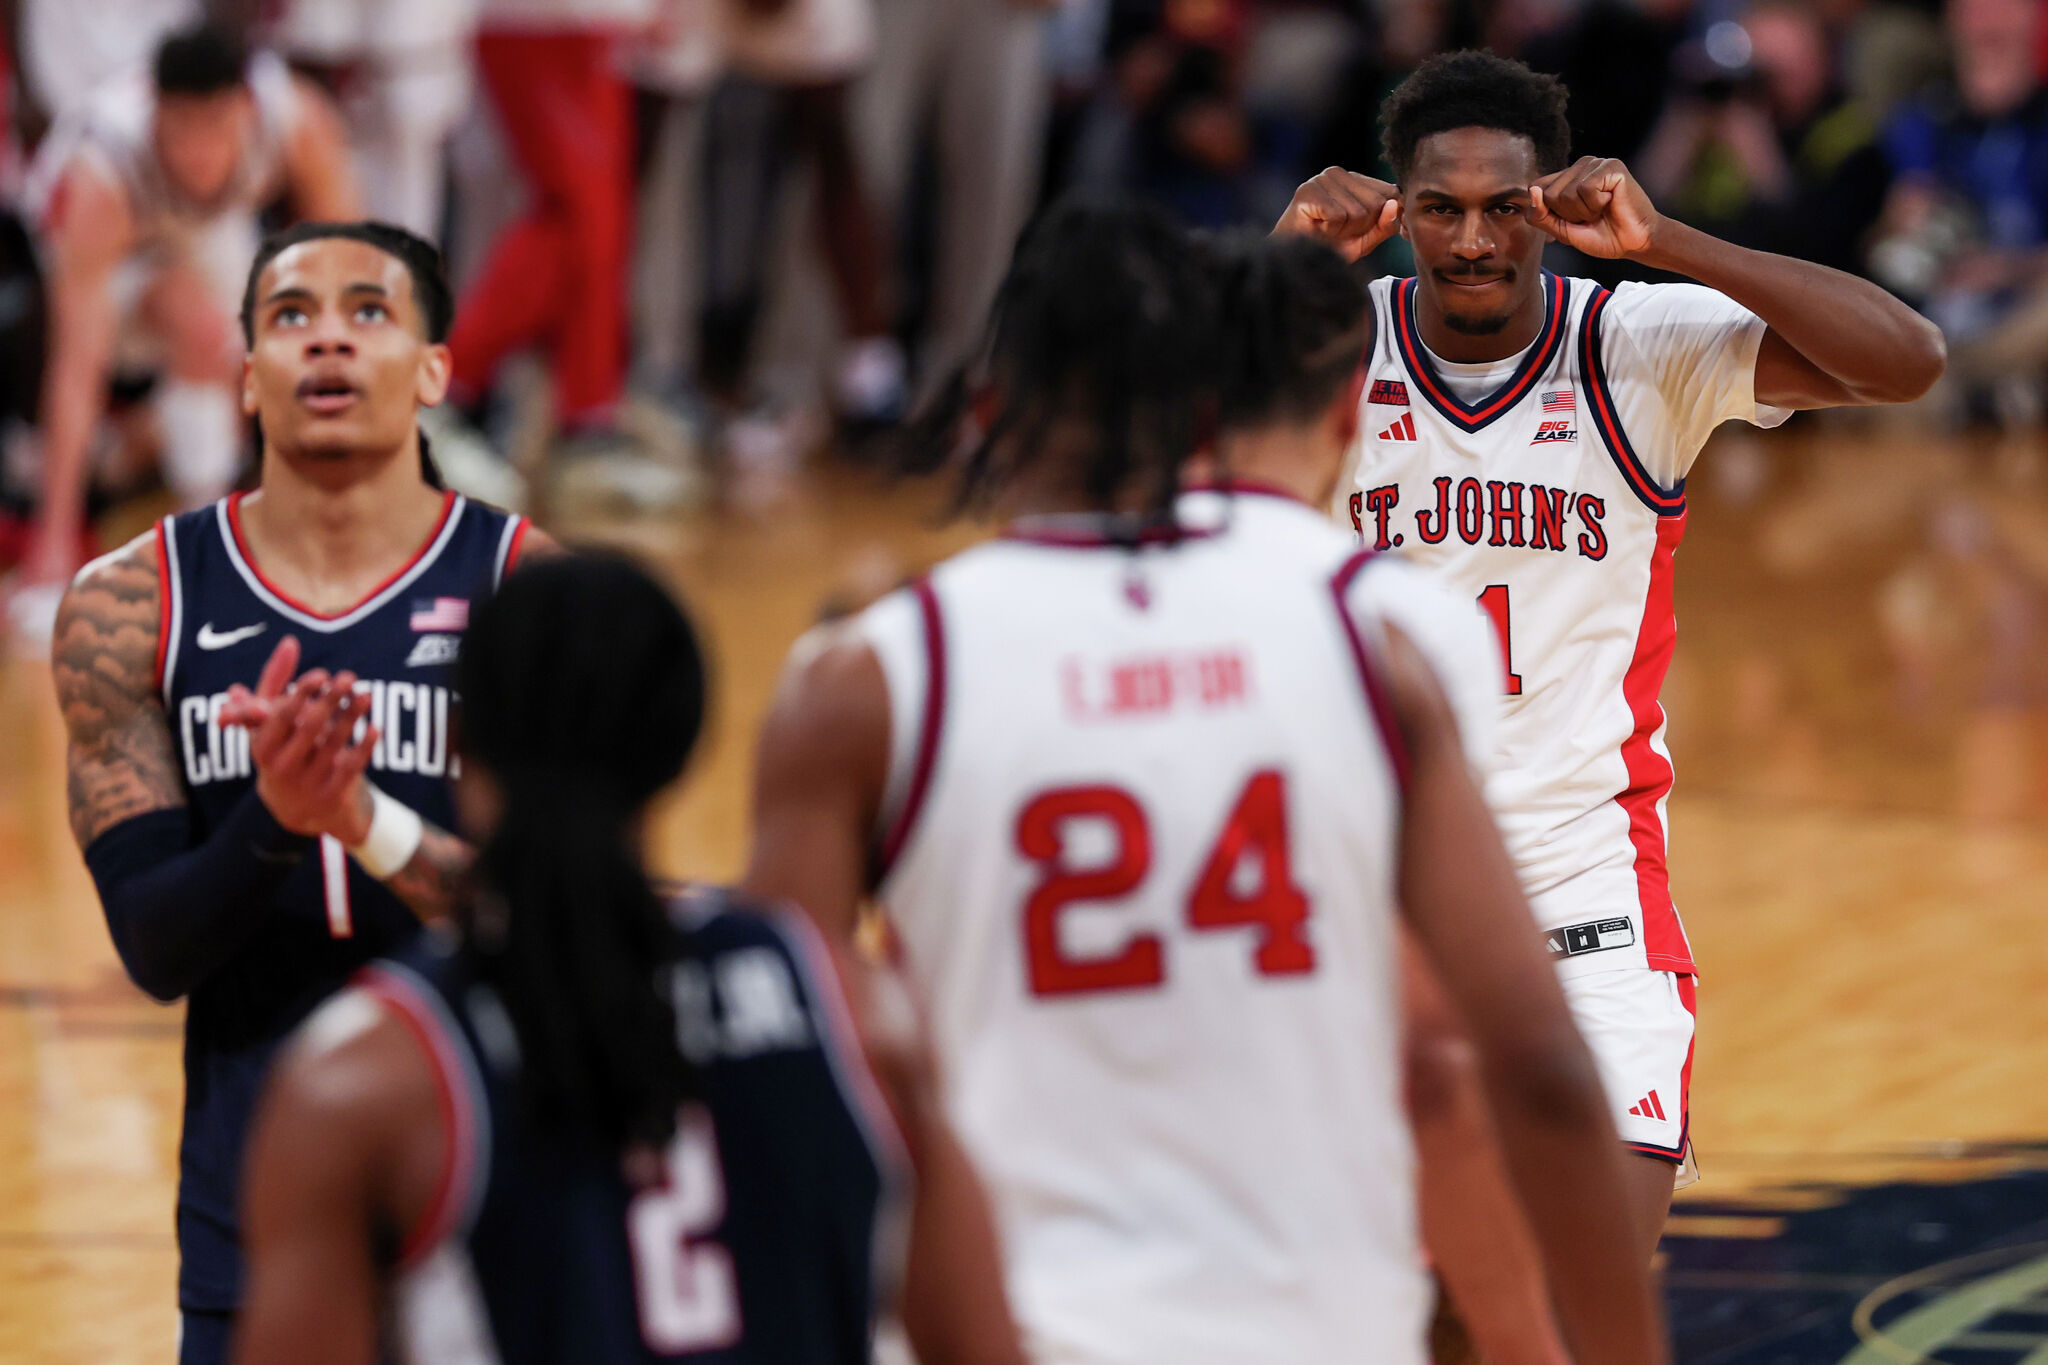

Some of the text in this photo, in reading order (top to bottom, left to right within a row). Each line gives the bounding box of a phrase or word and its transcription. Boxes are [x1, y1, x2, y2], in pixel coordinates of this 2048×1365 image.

[1533, 430, 1577, 441] EAST
[1538, 421, 1570, 431] BIG
[1349, 476, 1608, 561] ST. JOHN'S
[1475, 584, 1523, 695] 1
[1012, 767, 1316, 999] 24
